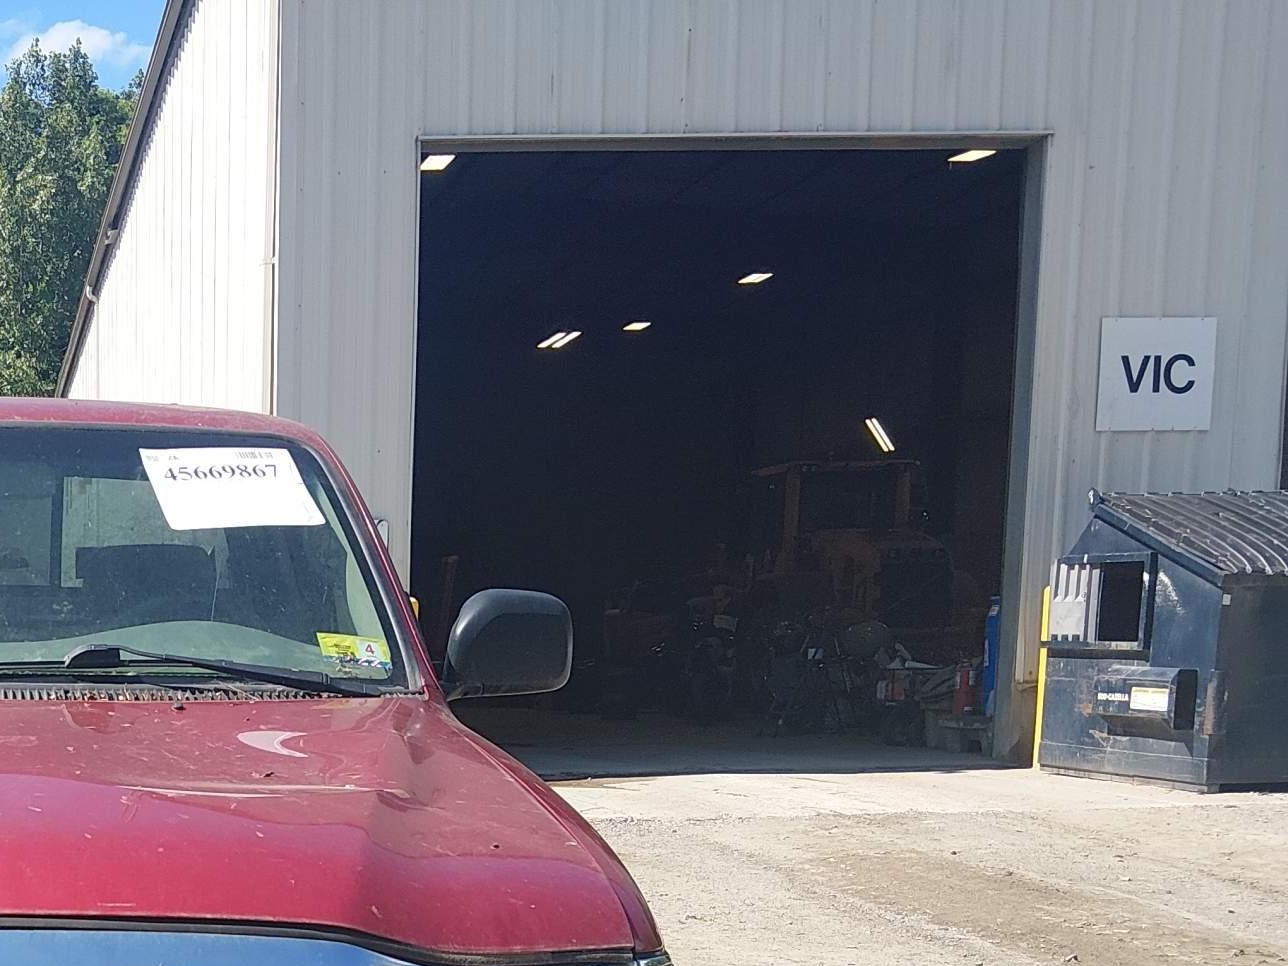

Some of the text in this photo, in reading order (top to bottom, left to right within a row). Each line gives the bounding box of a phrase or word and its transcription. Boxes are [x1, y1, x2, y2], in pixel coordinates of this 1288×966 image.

[1120, 353, 1196, 395] VIC
[164, 464, 277, 482] 45669867
[364, 643, 375, 655] 4
